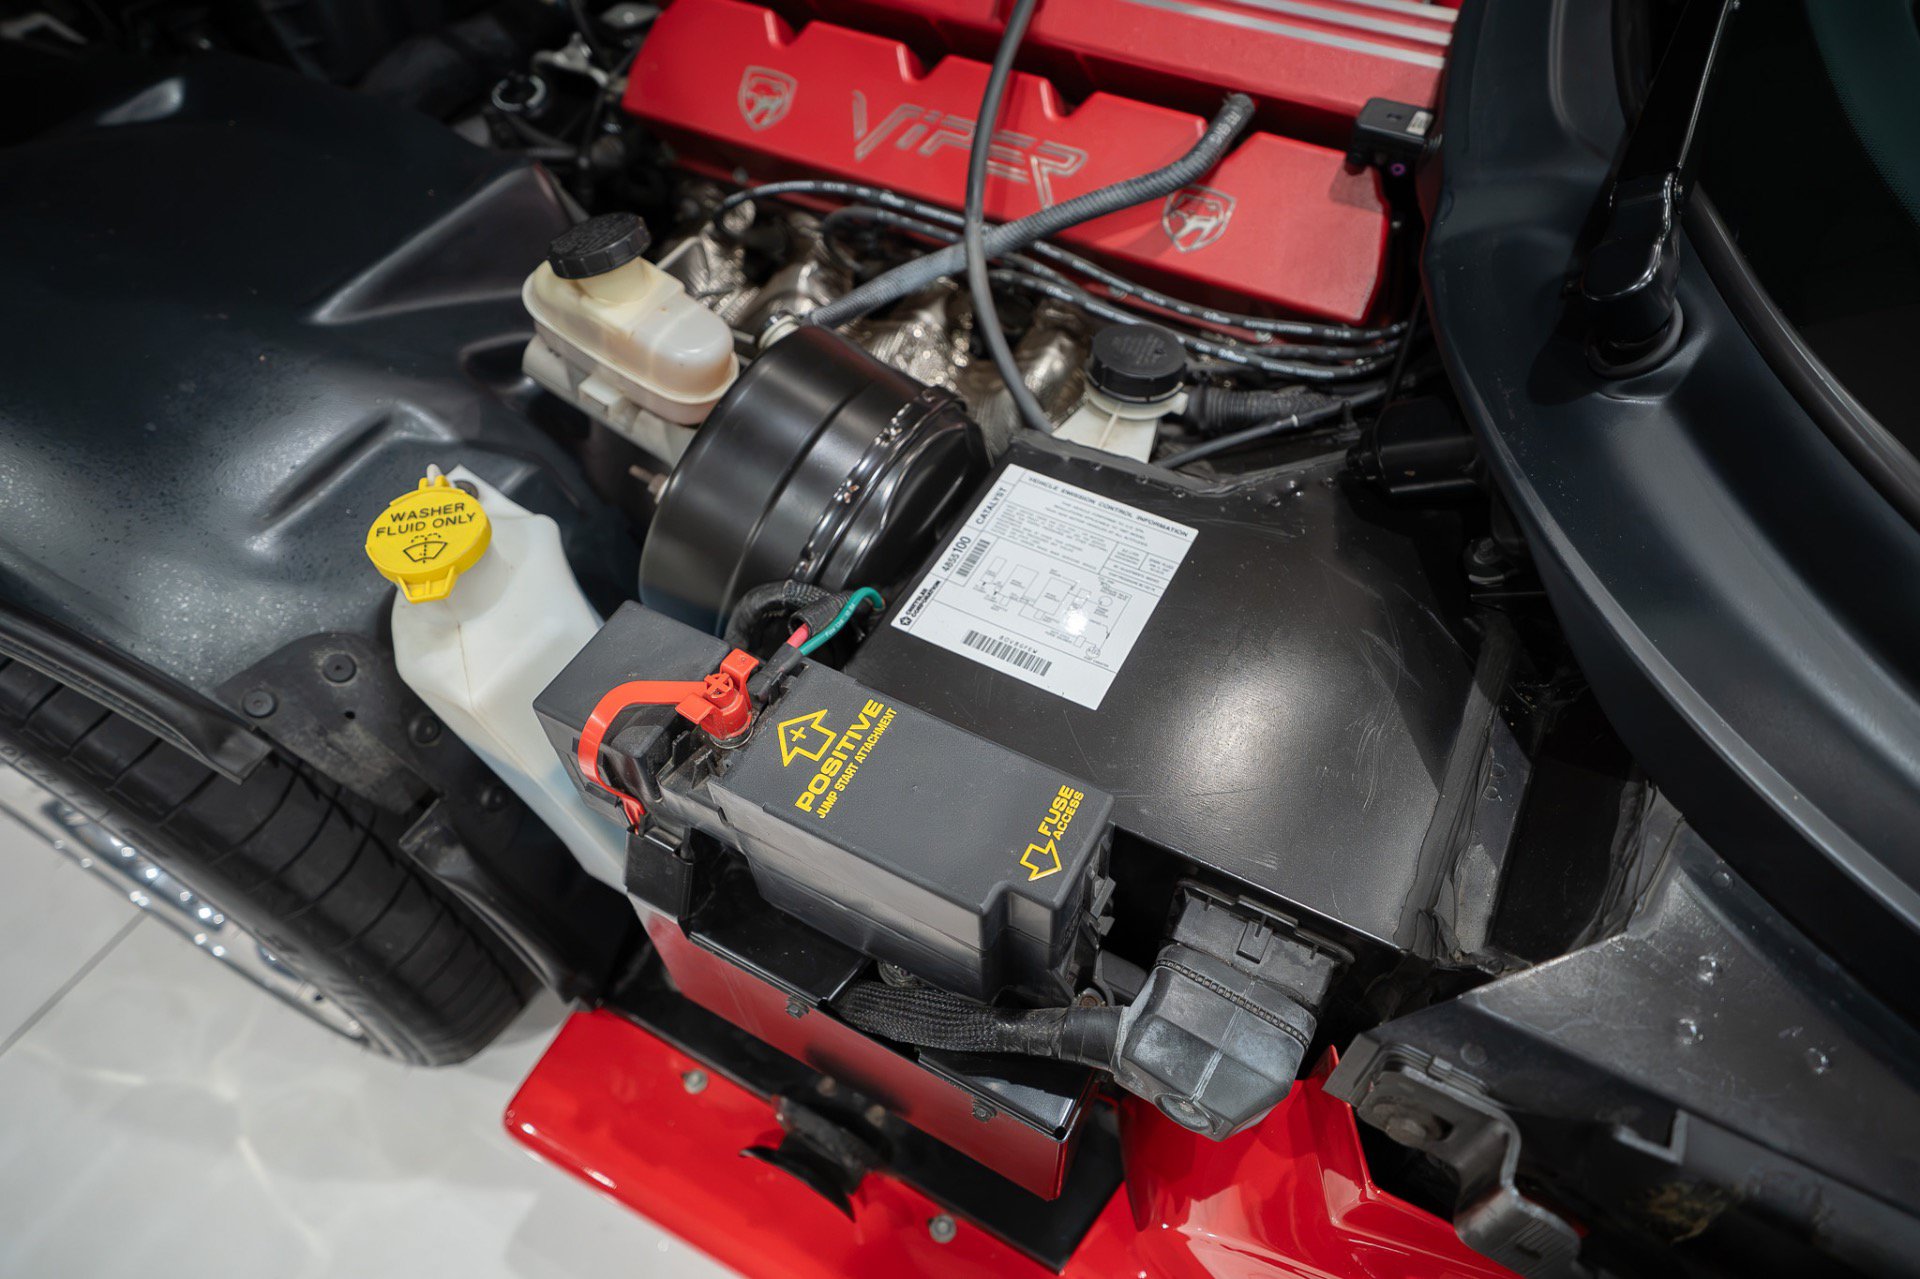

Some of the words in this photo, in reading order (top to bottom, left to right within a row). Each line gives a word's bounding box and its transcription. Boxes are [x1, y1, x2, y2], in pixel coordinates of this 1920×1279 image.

[375, 521, 426, 538] FLUID
[432, 512, 476, 529] ONLY
[390, 502, 465, 523] WASHER
[975, 486, 1007, 525] CATALYST
[1098, 502, 1133, 518] CONTROL
[1137, 515, 1189, 537] INFORMATION
[795, 699, 885, 813] POSITIVE
[816, 790, 838, 819] JUMP
[834, 762, 859, 792] START
[854, 707, 897, 764] ATTACHMENT
[1037, 785, 1074, 837] FUSE
[1052, 790, 1085, 841] ACCESS
